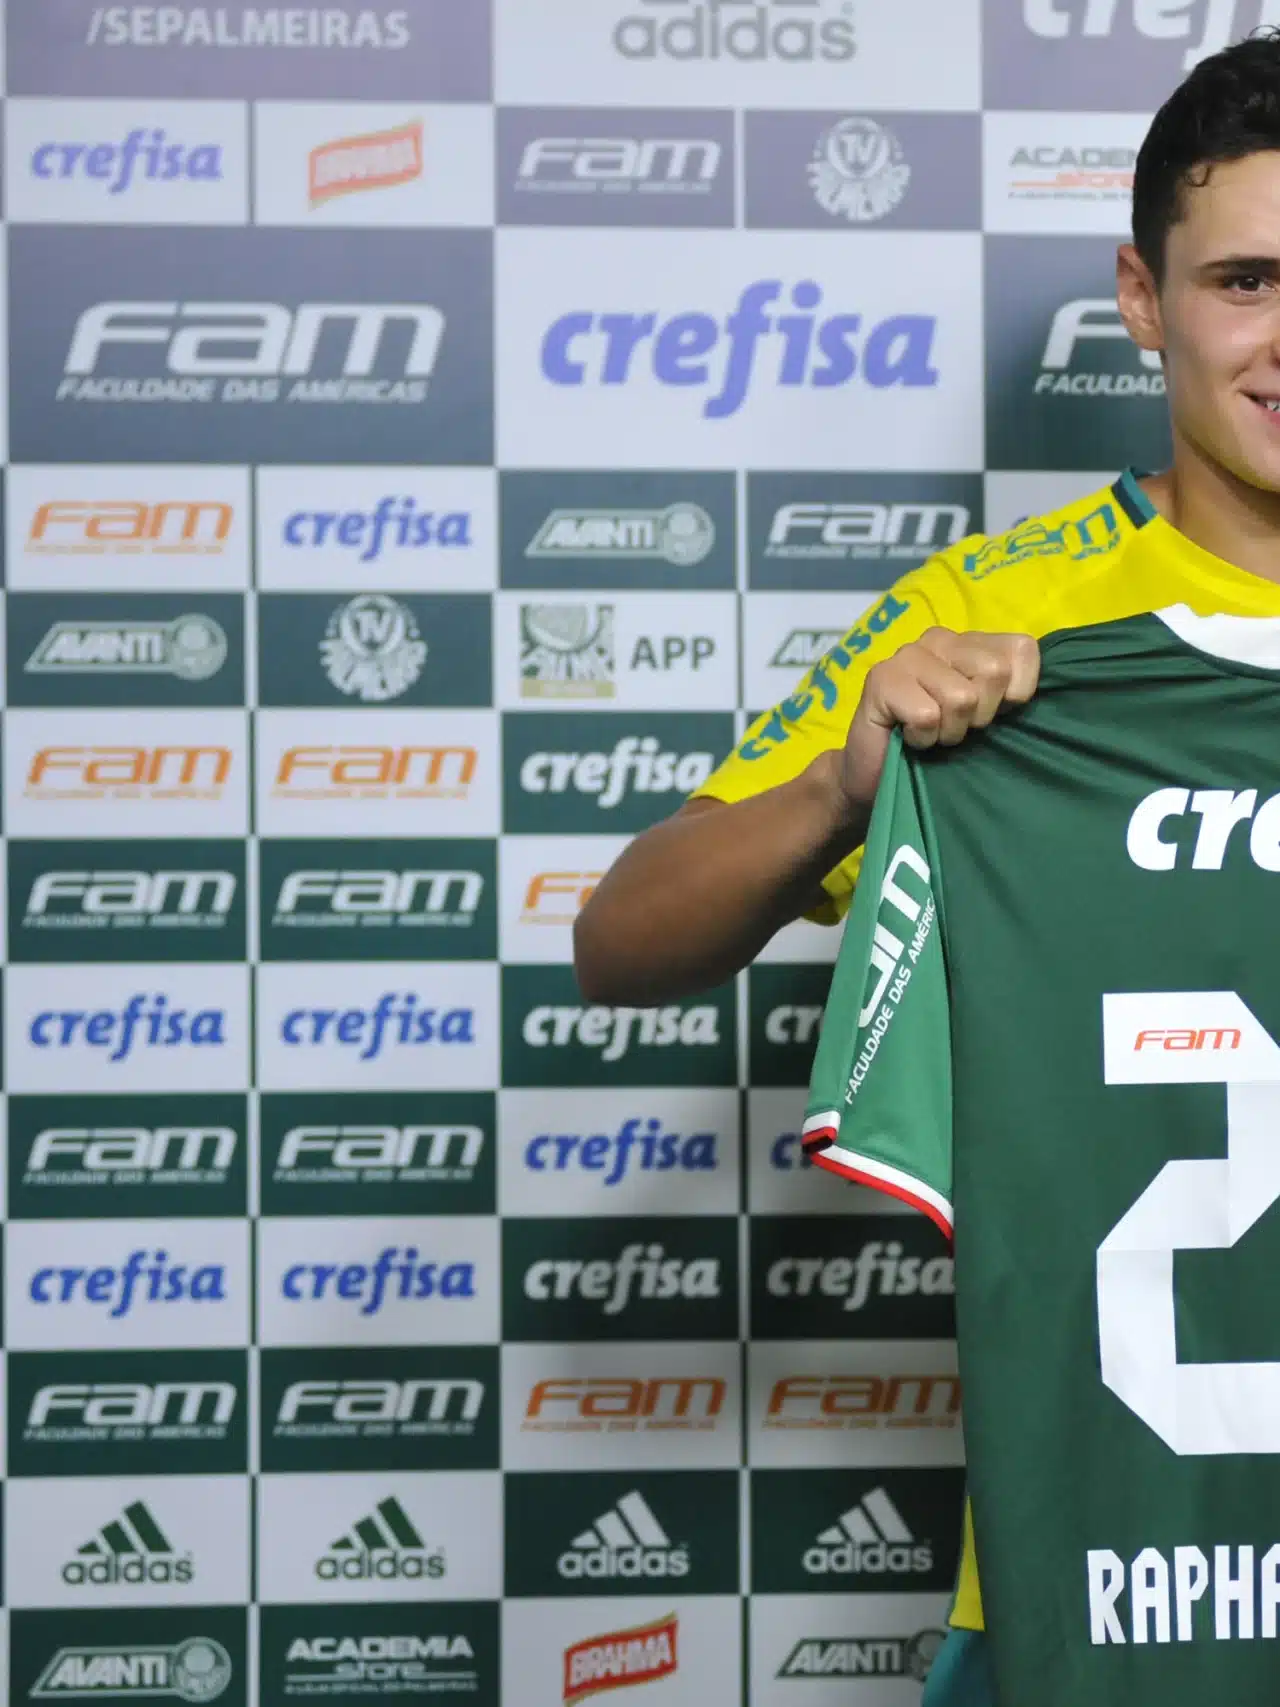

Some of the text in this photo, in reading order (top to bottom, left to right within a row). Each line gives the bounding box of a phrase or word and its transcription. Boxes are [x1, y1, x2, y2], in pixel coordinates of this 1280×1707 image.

[87, 9, 410, 49] /SEPALMEIRAS
[613, 5, 857, 62] adidas
[31, 129, 222, 194] crefisa
[540, 280, 940, 419] crefisa
[284, 495, 472, 562] crefisa
[630, 636, 716, 671] APP
[737, 593, 911, 761] crefisa
[520, 737, 714, 808] crefisa
[888, 963, 912, 1005] DAS
[29, 993, 227, 1062] crefisa
[282, 991, 474, 1060] crefisa
[522, 1005, 720, 1062] crefisa
[525, 1117, 718, 1186] crefisa
[29, 1249, 226, 1319] crefisa
[281, 1246, 475, 1316] crefisa
[523, 1242, 720, 1315] crefisa
[766, 1239, 954, 1311] crefisa
[61, 1549, 194, 1584] adidas
[315, 1546, 446, 1581] adidas
[557, 1544, 690, 1578] adidas
[802, 1541, 933, 1574] adidas
[49, 1655, 167, 1688] AVANTI
[285, 1635, 475, 1661] ACADEMIA
[568, 1633, 674, 1688] BRAHMA
[784, 1643, 899, 1674] AVANTI
